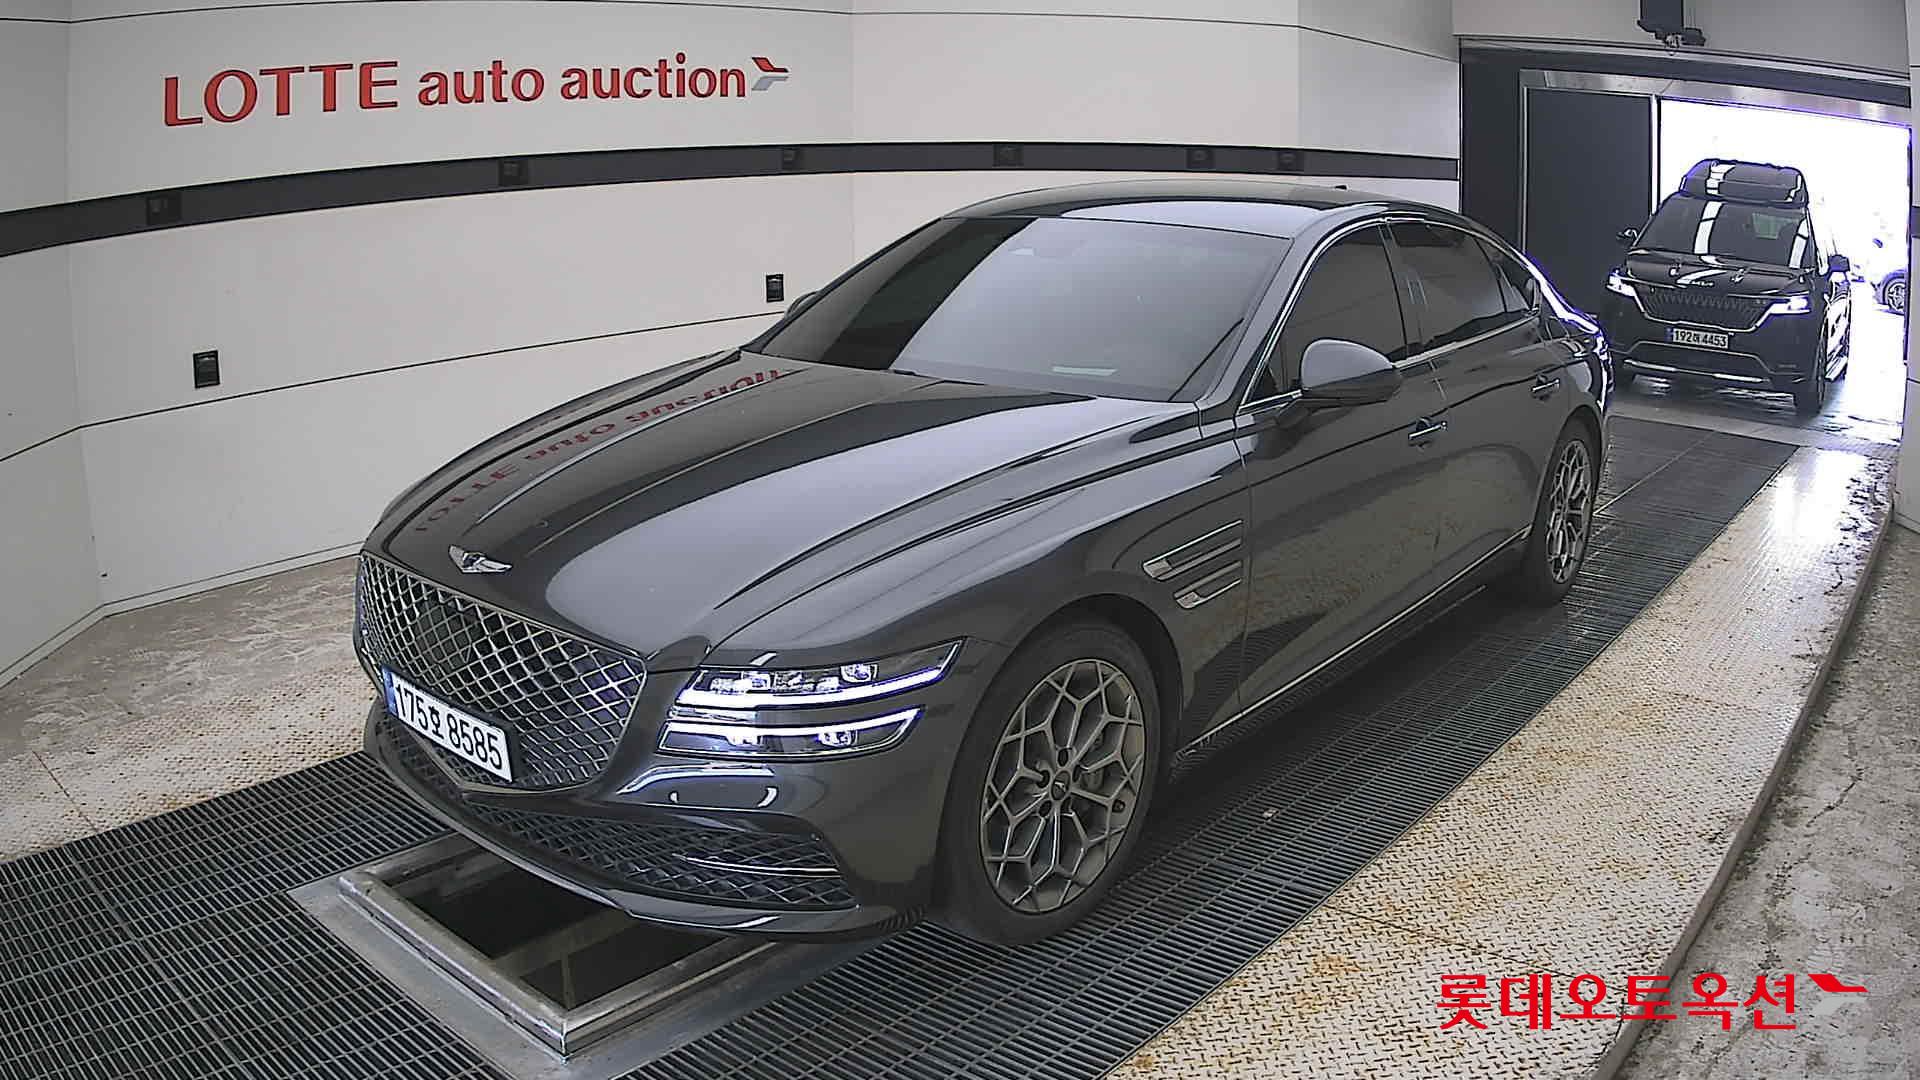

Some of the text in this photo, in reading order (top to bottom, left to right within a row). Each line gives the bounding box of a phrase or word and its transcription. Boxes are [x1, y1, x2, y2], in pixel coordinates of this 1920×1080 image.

[163, 52, 747, 127] LOTTE auto auction
